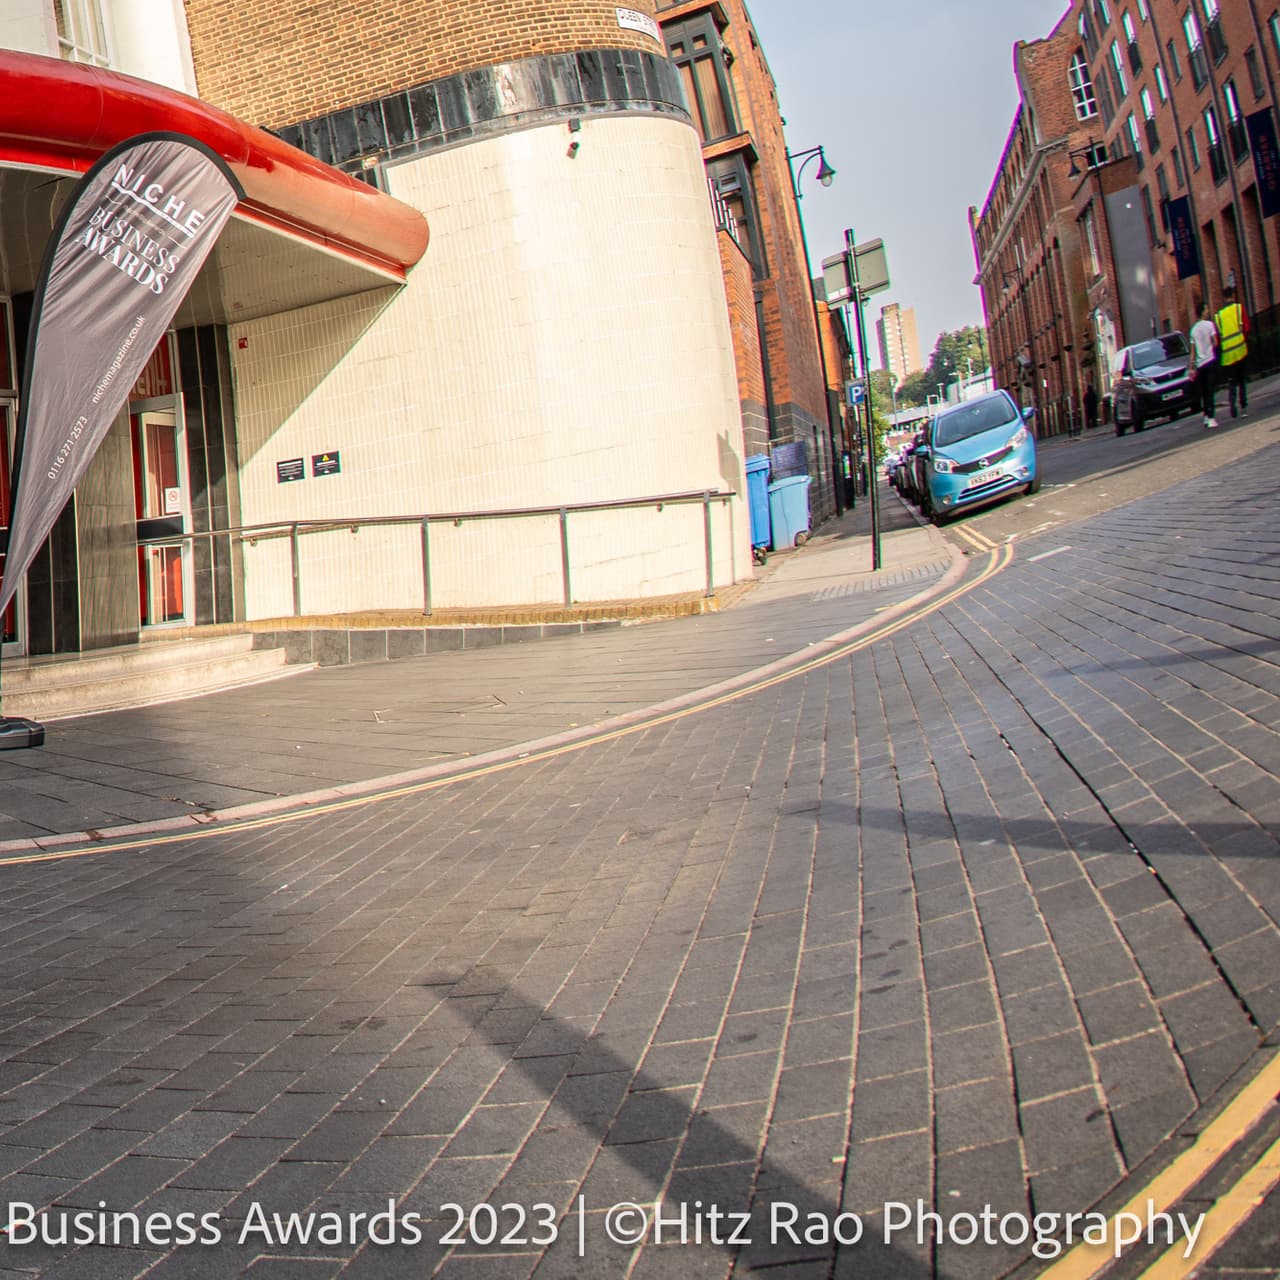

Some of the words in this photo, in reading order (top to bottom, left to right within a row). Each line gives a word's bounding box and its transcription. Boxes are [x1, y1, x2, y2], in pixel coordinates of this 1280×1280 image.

[114, 164, 205, 235] NICHE
[75, 227, 169, 295] AWARDS
[89, 206, 180, 274] BUSINESS
[92, 315, 146, 405] nichemagazine.co.uk
[852, 386, 863, 403] P
[47, 456, 65, 480] 0116
[60, 438, 75, 458] 271
[70, 415, 88, 440] 2573
